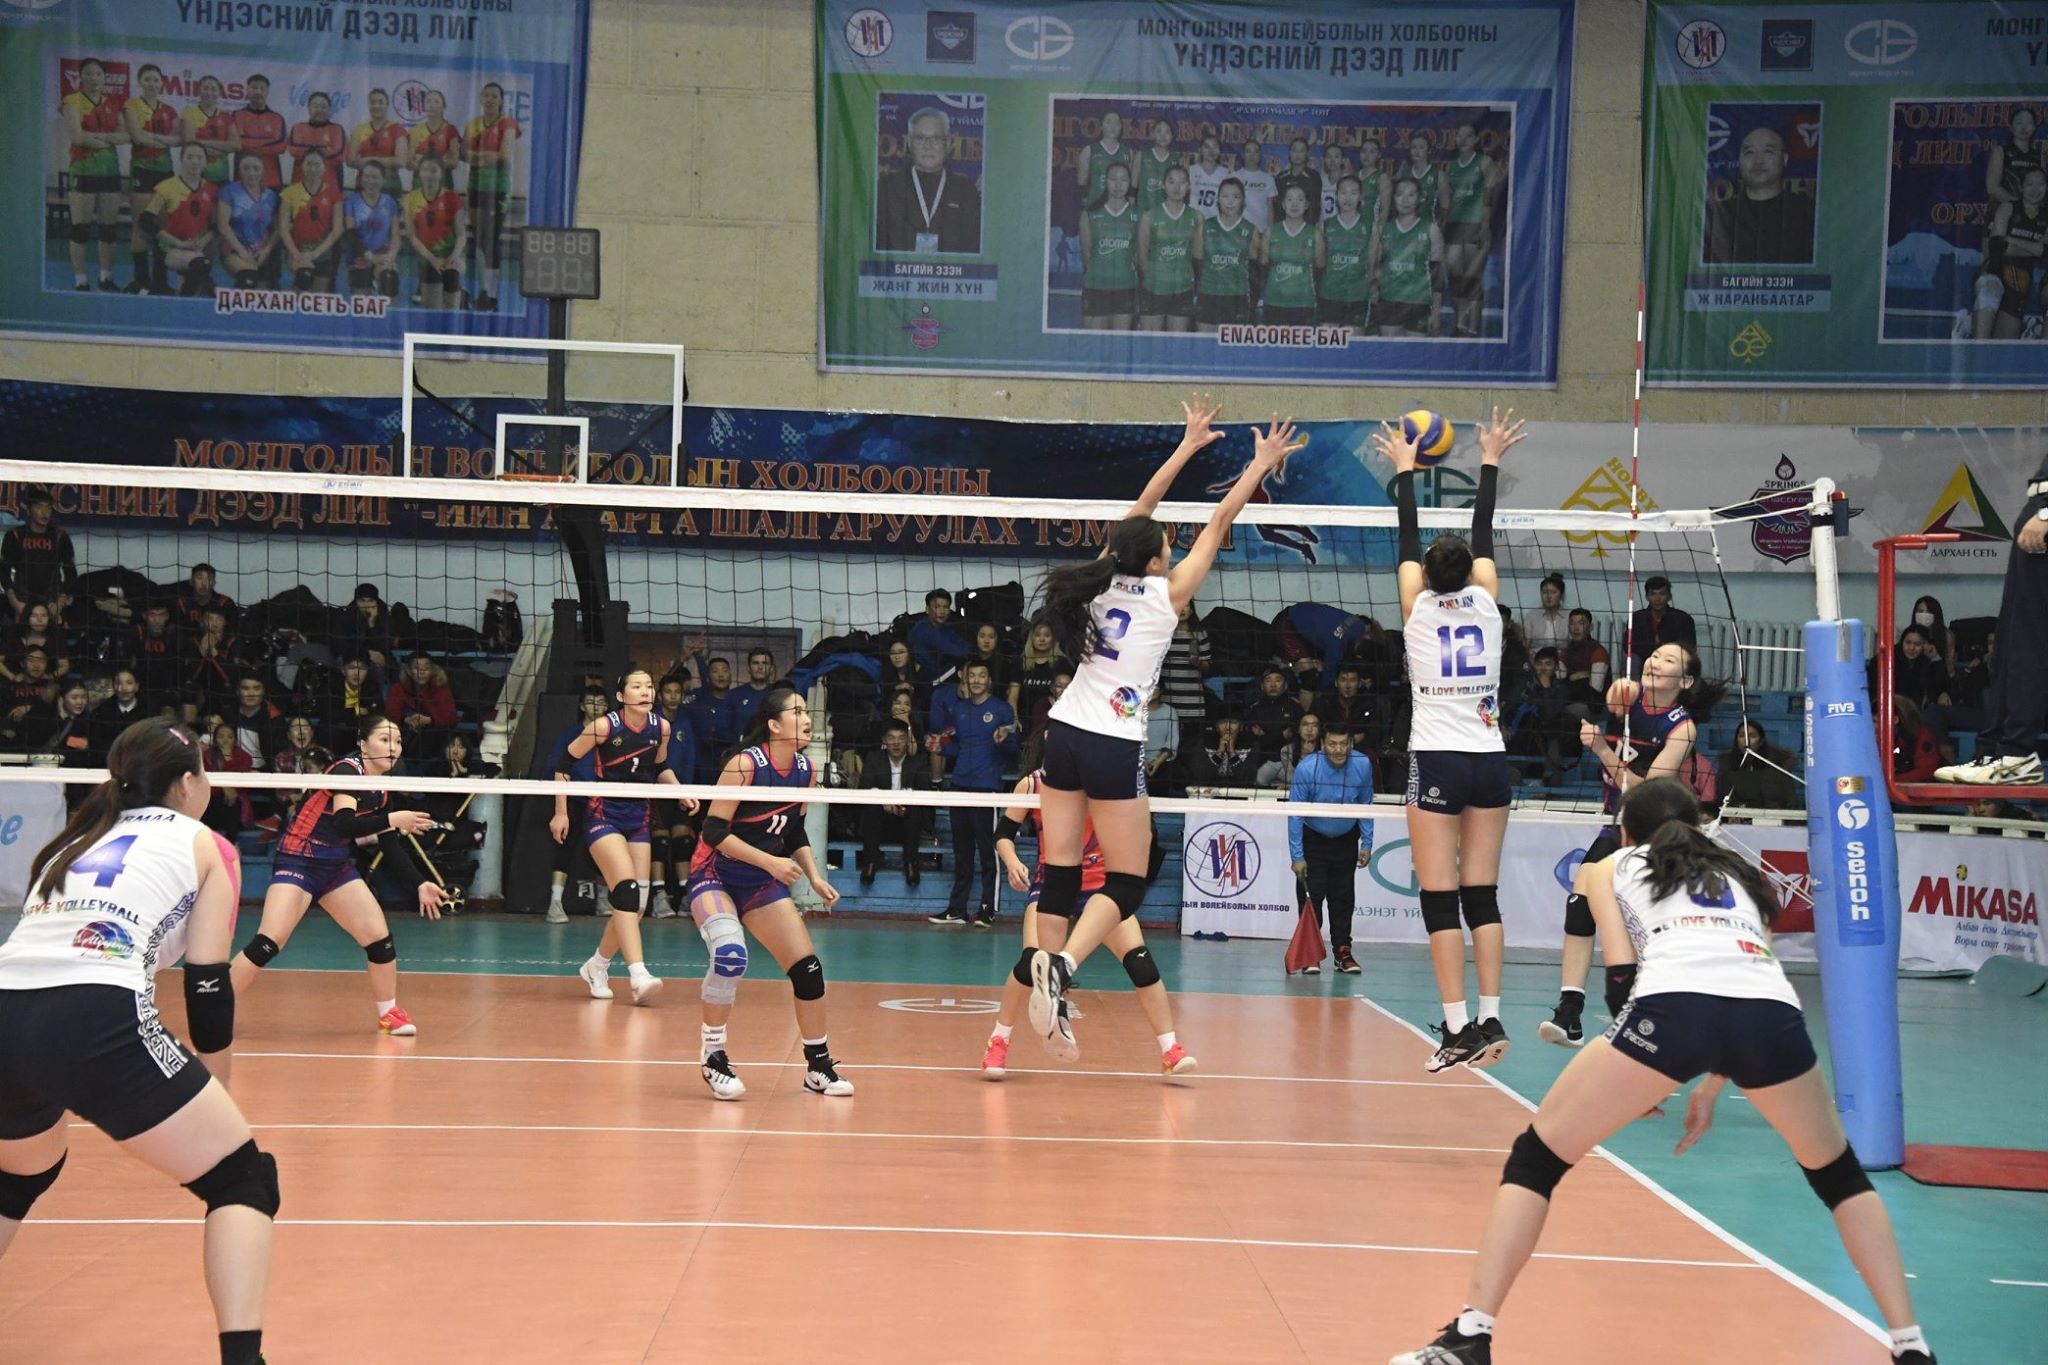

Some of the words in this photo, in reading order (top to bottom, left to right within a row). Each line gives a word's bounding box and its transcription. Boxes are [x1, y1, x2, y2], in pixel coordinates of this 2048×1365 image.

[176, 0, 334, 33] ҮНДЭСНИЙ
[342, 9, 420, 43] ДЭЭД
[428, 16, 480, 41] ЛИГ
[1138, 19, 1247, 44] МОНГОЛЫН
[1253, 19, 1383, 42] ВОЛЕЙБОЛЫН
[1391, 24, 1498, 42] ХОЛБООНЫ
[1174, 41, 1321, 74] ҮНДЭСНИЙ
[1329, 48, 1404, 76] ДЭЭД
[1412, 48, 1465, 72] ЛИГ
[895, 263, 933, 275] БАГИЙН
[936, 265, 962, 276] ЭЗЭН
[872, 280, 912, 292] ЖАНГ
[917, 281, 949, 294] ЖИН
[1722, 276, 1764, 288] БАГИЙН
[1766, 277, 1794, 288] ЭЗЭН
[217, 290, 295, 312] ДАРХАН
[301, 294, 347, 314] СЕТЬ
[353, 297, 389, 316] БАГ
[1714, 293, 1815, 306] НАРАНБААТАР
[1220, 326, 1312, 345] ENACOREE
[1317, 328, 1350, 346] БАГ
[174, 438, 434, 479] МОНГОЛЫН
[446, 444, 742, 489] ВОЛЙБОЛЫН
[750, 459, 991, 496] ХОЛБООНЫ
[1765, 480, 1806, 490] SPRINGS
[187, 489, 304, 530] ДЭЭД
[1929, 547, 1970, 557] ДАРХАН
[1972, 549, 1997, 558] СЕТЬ
[1092, 607, 1132, 662] 2
[1436, 624, 1487, 678] 12
[1419, 685, 1430, 696] WE
[1432, 685, 1455, 696] LOVE
[1827, 702, 1856, 714] FIVB
[766, 814, 788, 834] 11
[69, 834, 138, 889] 4
[56, 898, 141, 926] VOLLEYBALL
[1200, 902, 1256, 911] ВОЛЕЙБОЛЫН
[1257, 904, 1290, 912] ХОЛБОО
